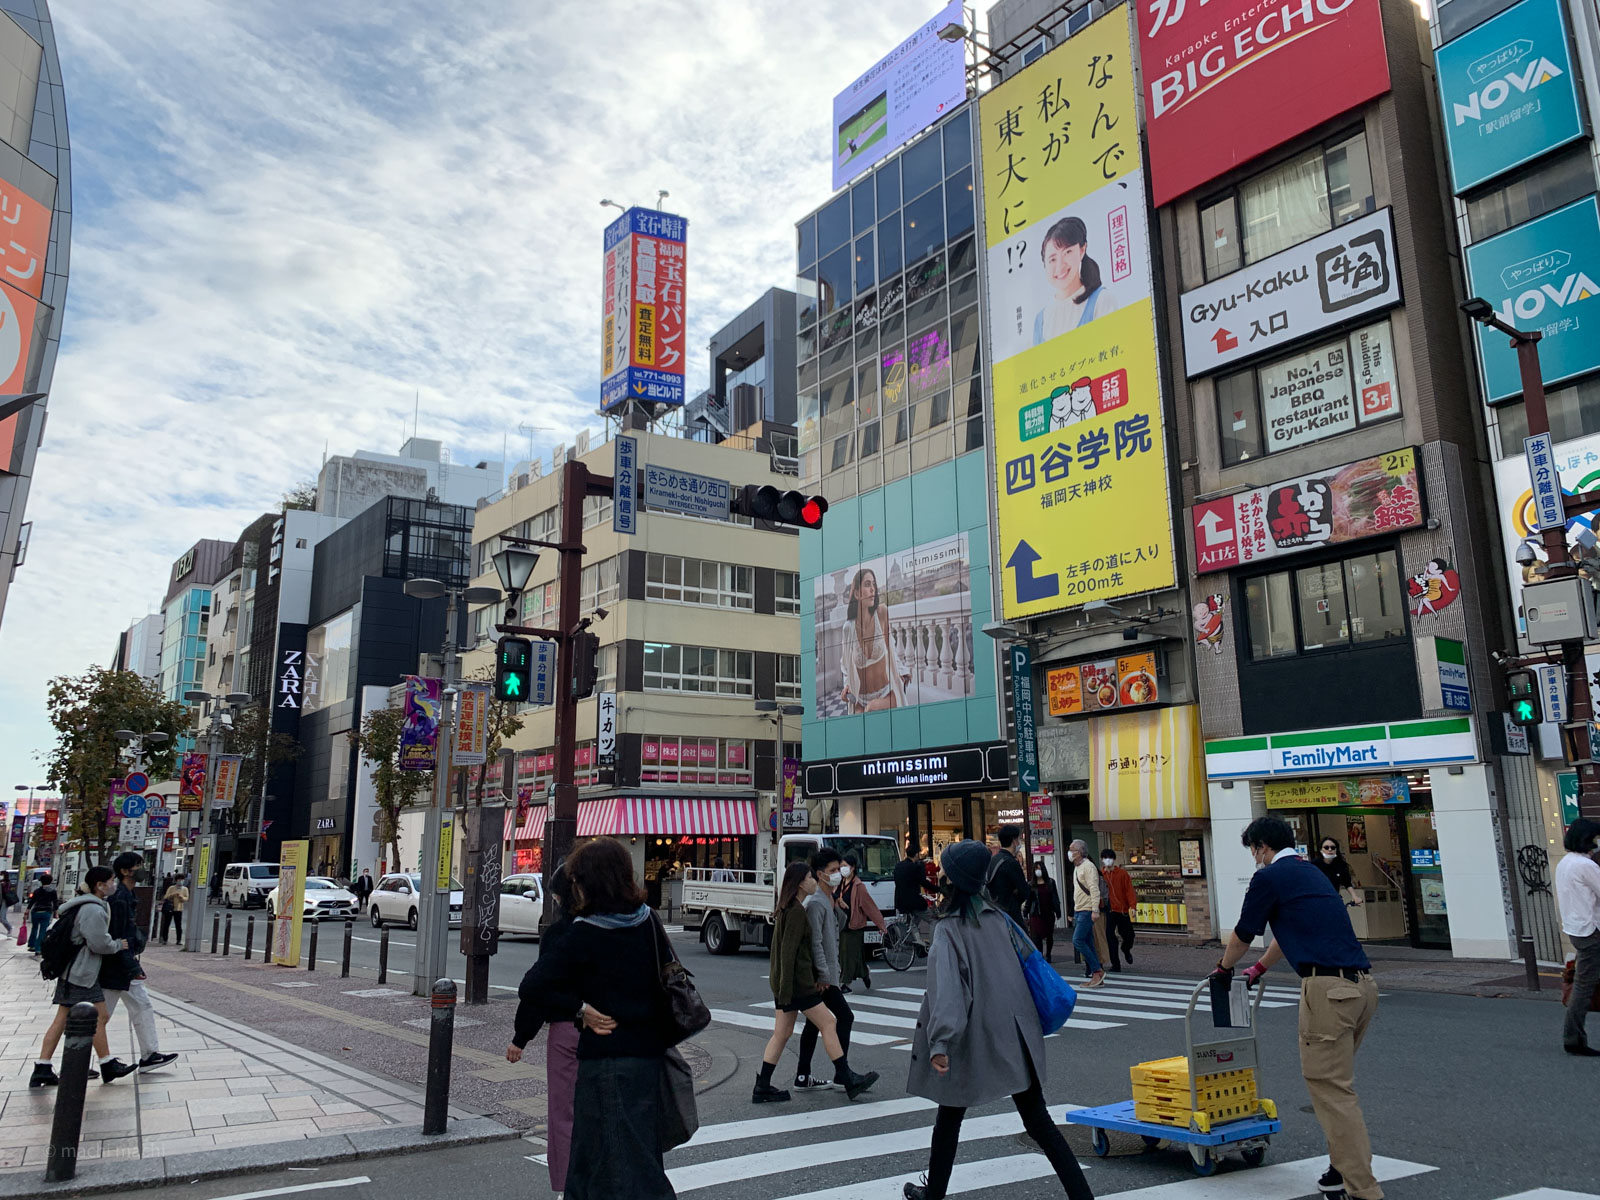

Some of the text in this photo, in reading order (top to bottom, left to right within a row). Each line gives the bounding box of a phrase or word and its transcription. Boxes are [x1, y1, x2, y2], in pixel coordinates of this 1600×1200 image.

[1165, 0, 1277, 68] Karaoke Enterta
[1476, 48, 1524, 74] やっぱり。
[1151, 45, 1226, 119] BIG
[1453, 56, 1564, 127] NOVA
[1037, 78, 1071, 166] 私が
[1087, 54, 1128, 189] なんで、
[1478, 99, 1542, 137] 「駅前留学」
[636, 212, 683, 241] 宝石・時計
[1111, 213, 1128, 274] 理三合格
[659, 242, 684, 258] 福岡
[636, 236, 657, 305] 高価買取
[1328, 251, 1382, 289] 牛角
[1510, 256, 1560, 281] やっぱり。
[1190, 264, 1309, 324] Gyu-Kaku
[1489, 271, 1600, 333] NOVA
[658, 257, 684, 369] 宝石バンク
[1249, 310, 1289, 342] 入口
[638, 306, 653, 363] 査定無料
[1018, 345, 1125, 395] 進化させるダブル教育。
[1287, 360, 1321, 381] No.1
[1359, 332, 1373, 385] Building's
[1373, 343, 1381, 367] This
[647, 382, 682, 401] 当ビル1F
[1102, 375, 1119, 392] 55
[1270, 368, 1344, 399] Japanese
[1291, 388, 1325, 409] BBQ
[1364, 390, 1390, 410] 3F
[1271, 394, 1349, 428] restaurant
[1274, 410, 1349, 441] Gyu-Kaku
[1005, 413, 1152, 495] 四谷学院
[1386, 453, 1411, 472] 2F
[619, 441, 632, 529] 歩車分離信号
[648, 470, 727, 499] きらめき通り西口
[650, 487, 726, 509] Kirameki-dori Nishiguchi
[1041, 474, 1113, 509] 福岡天神校
[1530, 439, 1558, 524] 歩車分離信号
[668, 499, 707, 512] INTERSECTION
[1250, 492, 1266, 553] 赤から鍋と
[1238, 502, 1253, 561] セセリ焼き
[1066, 543, 1160, 579] 左手の道に入り
[1200, 546, 1236, 566] 入口左
[1067, 572, 1124, 596] 200m先
[536, 644, 548, 702] 歩車分離信号
[1015, 651, 1026, 672] P
[1120, 660, 1128, 672] 5F
[1439, 666, 1466, 679] FamilyMart
[278, 650, 302, 708] ZARA
[1546, 668, 1561, 720] 歩車分離信号
[457, 691, 475, 752] 飲酒運転撲滅
[601, 697, 615, 750] 牛カツ
[1021, 676, 1034, 766] 福岡中央駐車場
[863, 756, 948, 776] intimissimi
[1107, 753, 1169, 771] 西通りプリン
[1282, 744, 1378, 768] FamilyMart
[896, 772, 948, 784] Italian lingerie
[128, 800, 138, 814] P
[317, 818, 334, 829] ZARA
